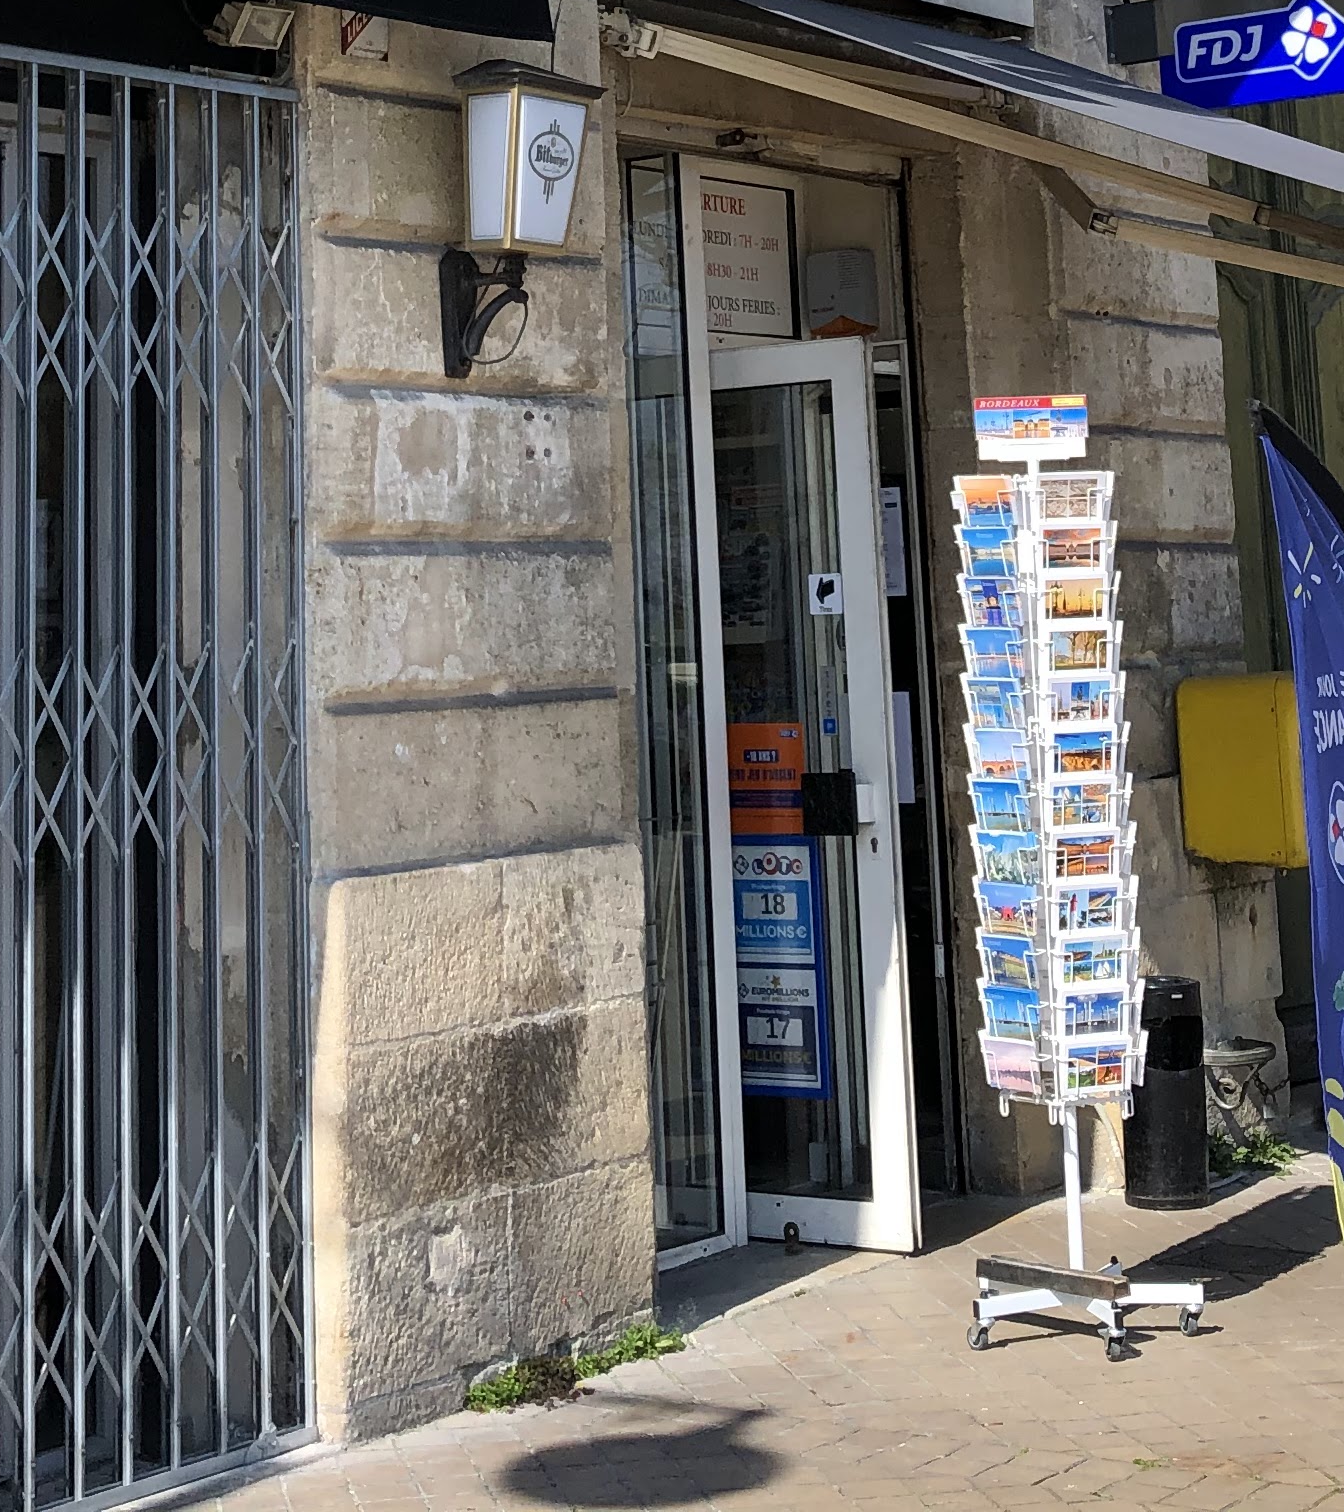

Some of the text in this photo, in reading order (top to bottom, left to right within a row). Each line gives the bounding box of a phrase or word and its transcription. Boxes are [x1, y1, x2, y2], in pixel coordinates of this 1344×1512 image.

[1186, 24, 1263, 70] FDJ
[760, 237, 779, 251] 20H
[740, 266, 759, 281] 21H
[708, 295, 740, 311] JOURS
[713, 313, 732, 328] 20H
[979, 399, 1040, 408] BORDEAUX
[752, 852, 803, 875] LOTO
[760, 892, 786, 915] 18
[736, 925, 794, 938] MILLIONS
[751, 987, 810, 997] EUROMILLIONS
[766, 1015, 790, 1039] 17
